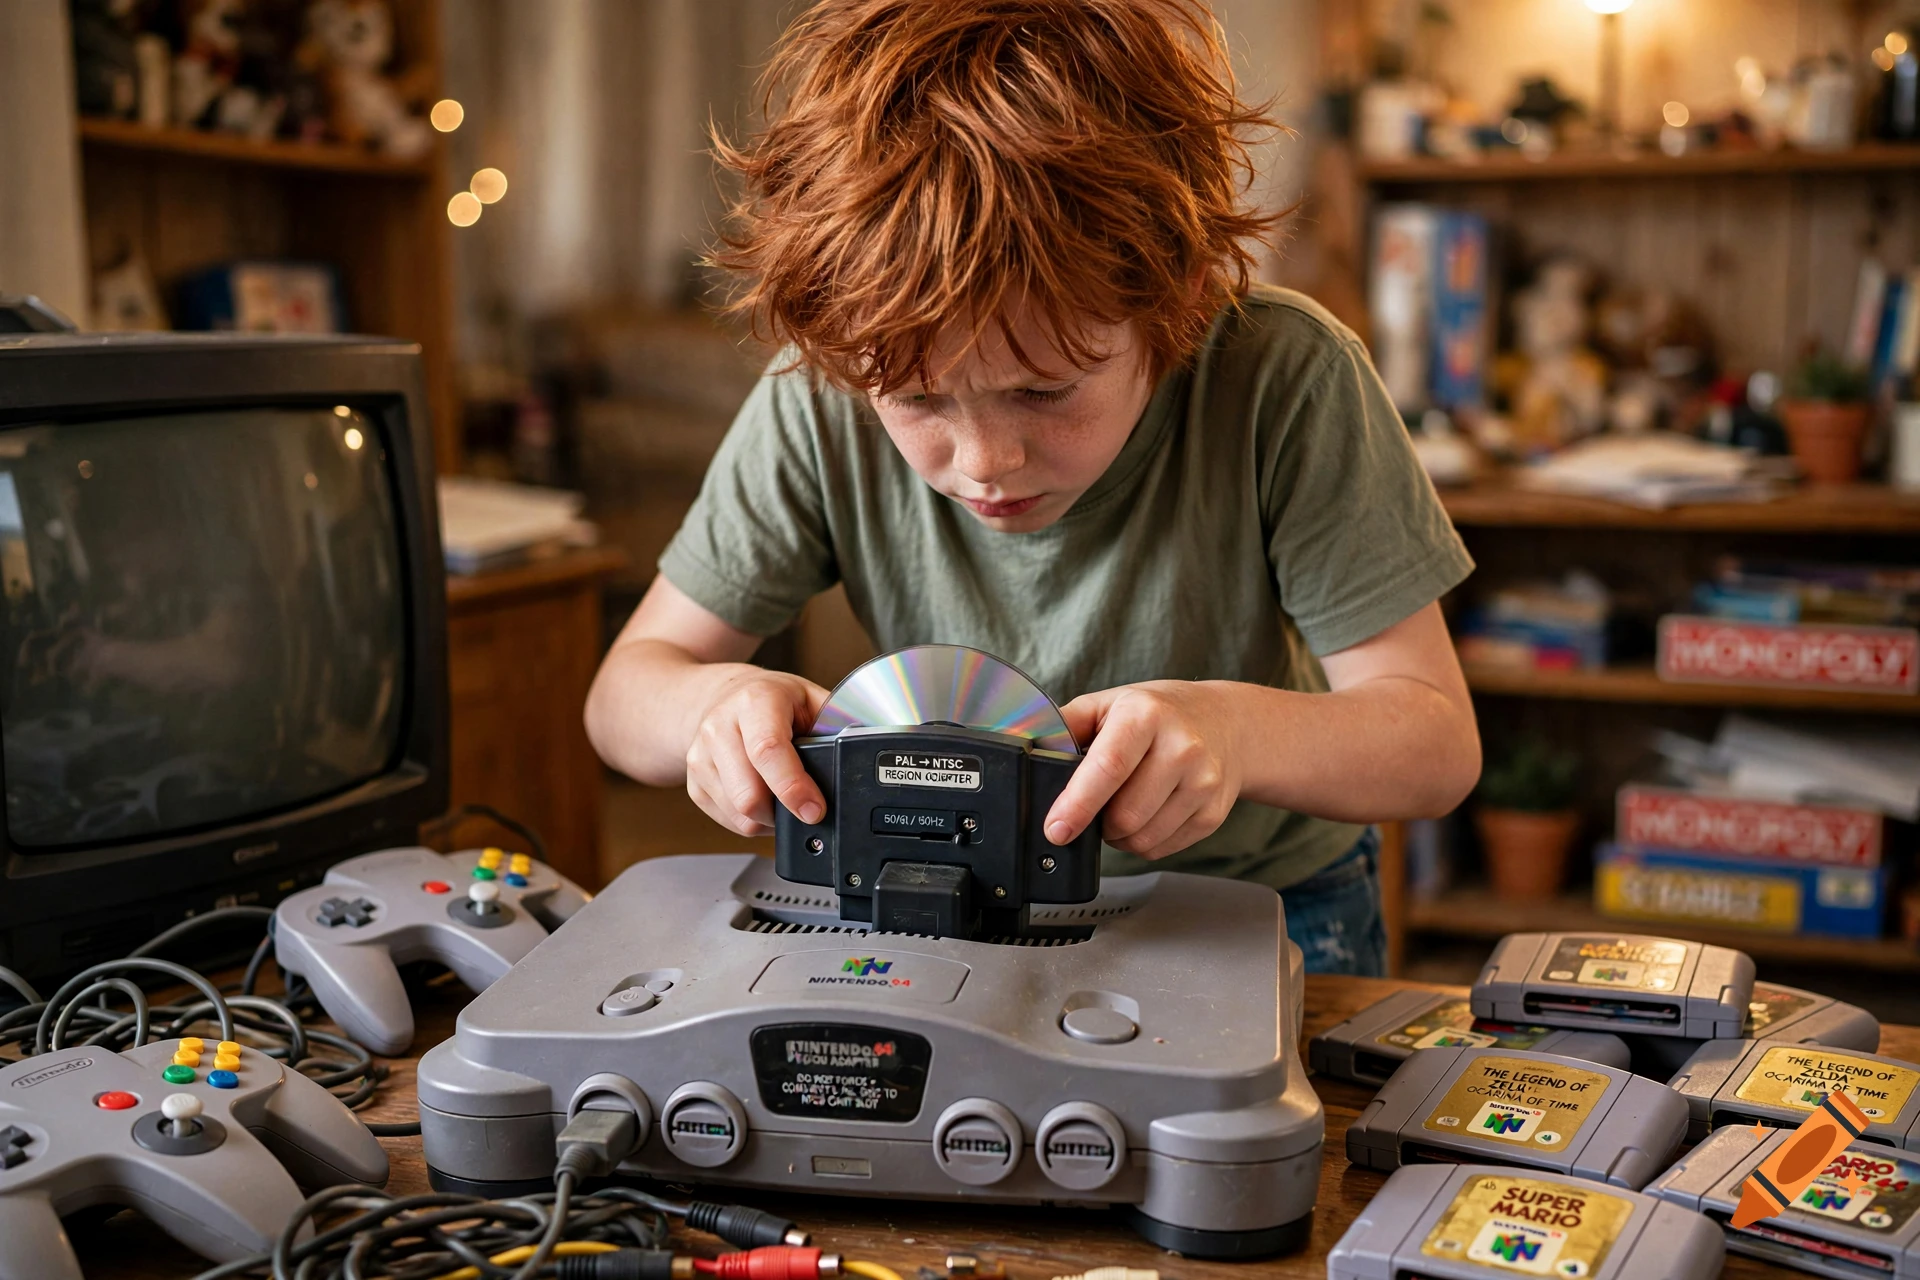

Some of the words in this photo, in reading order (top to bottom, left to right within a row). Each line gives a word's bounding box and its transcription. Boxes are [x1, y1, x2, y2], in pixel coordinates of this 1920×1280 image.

[895, 755, 917, 767] PAL
[932, 757, 964, 770] NTSC
[885, 769, 922, 781] REGION
[1483, 1066, 1508, 1080] THE
[1512, 1071, 1567, 1090] LEGEND
[1569, 1082, 1591, 1093] OF
[1786, 1055, 1813, 1068] THE
[1817, 1060, 1874, 1078] LEGEND
[1876, 1072, 1897, 1083] OF
[1831, 1082, 1851, 1093] OF
[1855, 1086, 1889, 1101] TIME
[1526, 1096, 1546, 1107] OF
[1548, 1100, 1580, 1112] TIME
[1502, 1186, 1586, 1214] SUPER
[1489, 1200, 1582, 1228] MARIO
